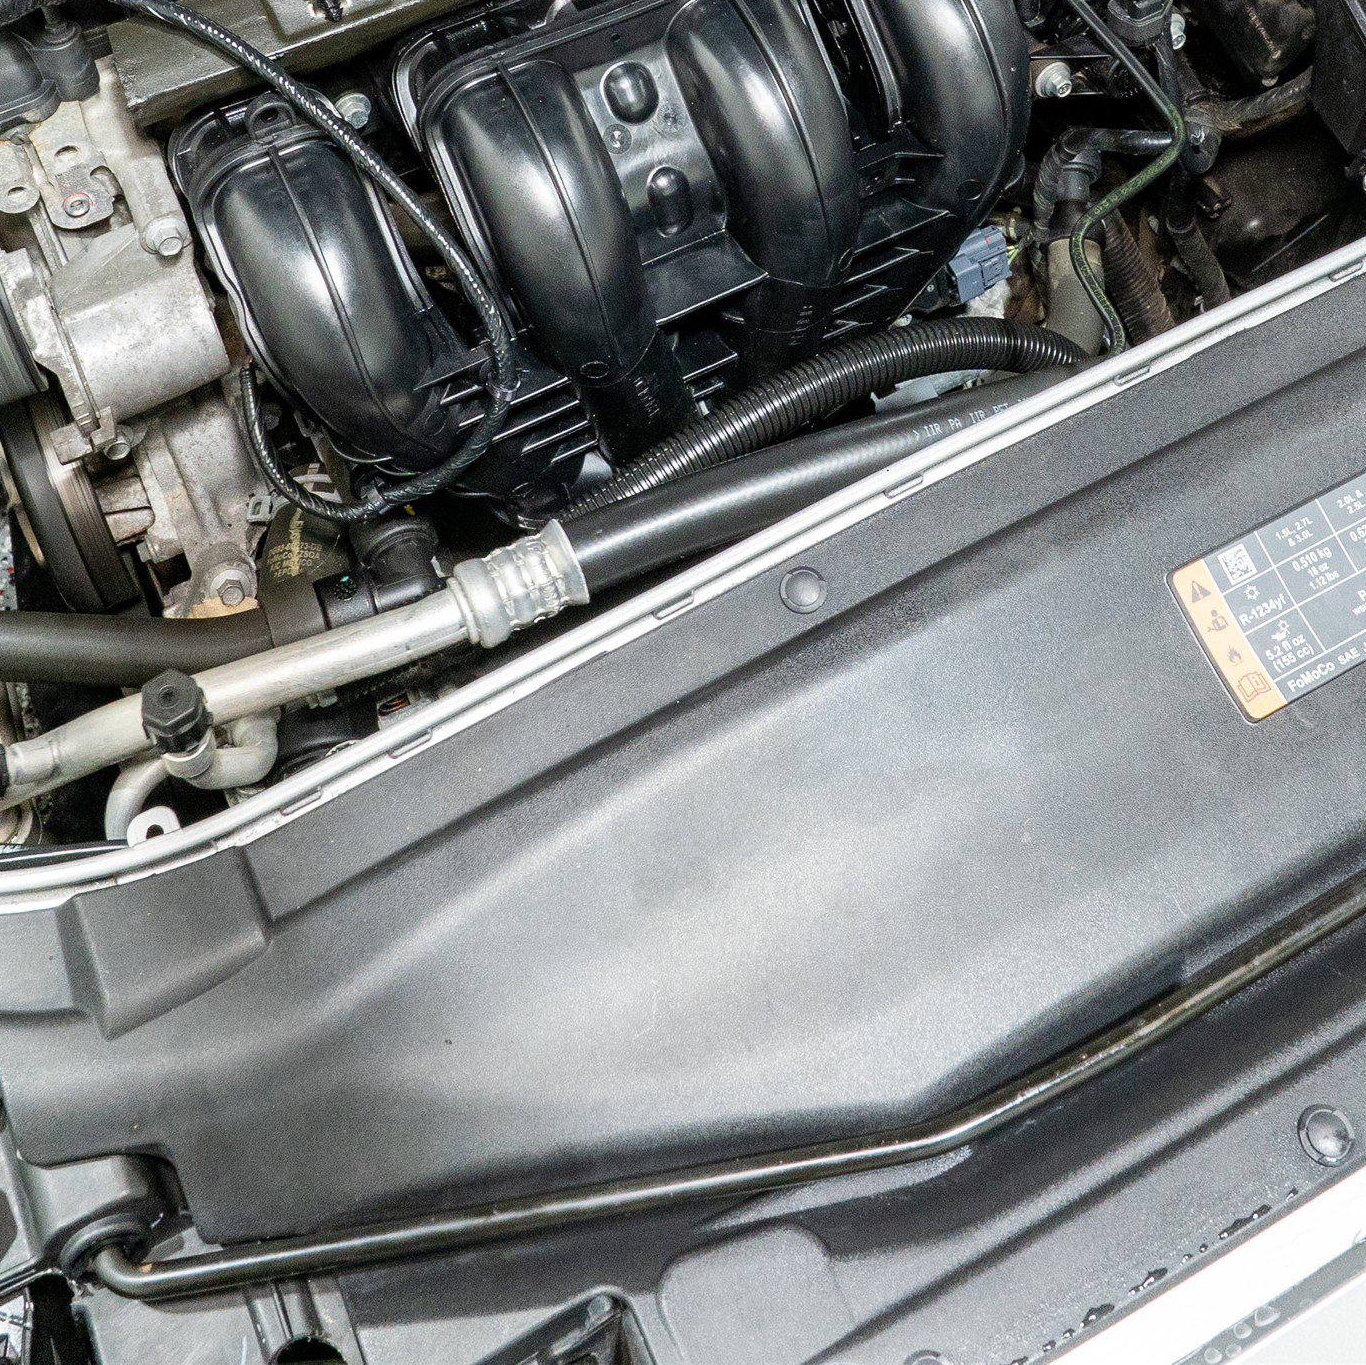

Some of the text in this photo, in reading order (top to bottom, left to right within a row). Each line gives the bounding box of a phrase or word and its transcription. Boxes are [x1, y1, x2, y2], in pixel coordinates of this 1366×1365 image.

[1337, 494, 1356, 508] 2.0L
[1347, 501, 1366, 514] 2.5L
[1295, 517, 1314, 531] 2.7L
[1295, 530, 1314, 543] 3.0L
[1292, 546, 1333, 572] 0.510 kg
[1307, 562, 1330, 578] 18 oz
[1309, 570, 1340, 590] 1.12 lbs
[1238, 593, 1287, 626] R-1234yf
[1265, 645, 1283, 661] 5.2
[1291, 634, 1306, 646] oz
[1273, 642, 1315, 673] (155 cc)
[1286, 661, 1336, 693] FoMoCo
[1337, 647, 1361, 665] SAE
